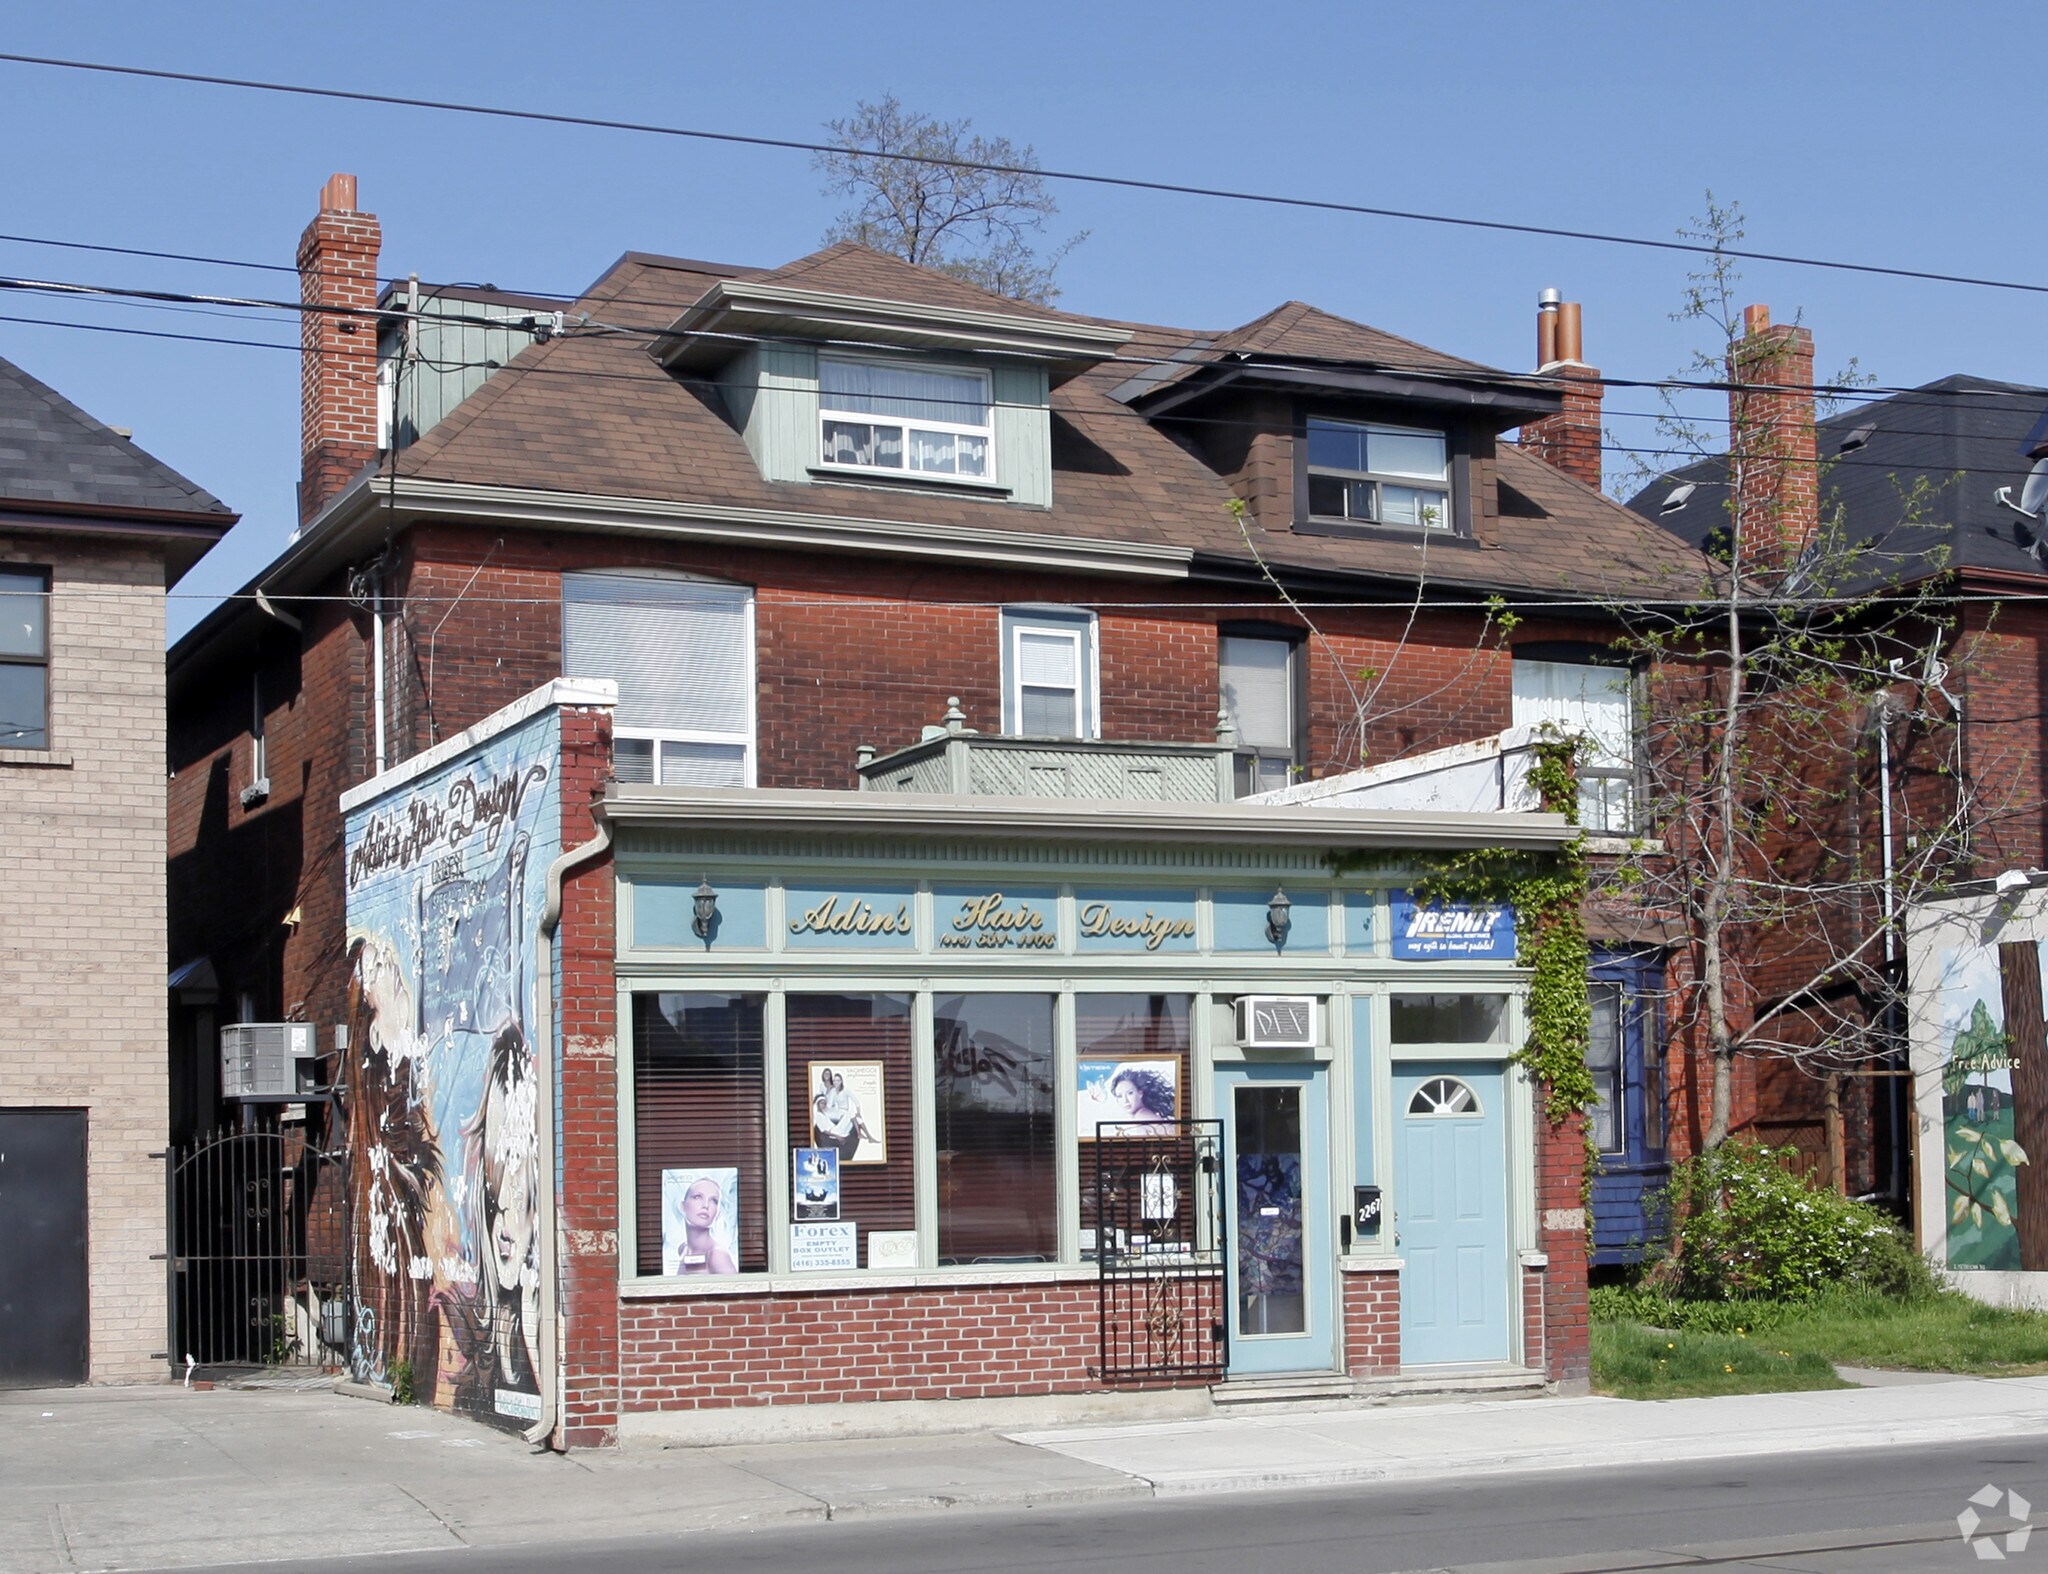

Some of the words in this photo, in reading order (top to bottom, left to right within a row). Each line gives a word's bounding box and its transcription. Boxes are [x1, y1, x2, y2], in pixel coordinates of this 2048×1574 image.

[401, 798, 447, 870] Hair
[449, 765, 548, 852] Design
[790, 894, 912, 934] Adin's
[953, 893, 1043, 931] Hair
[1081, 903, 1196, 949] Design
[1952, 1055, 1977, 1071] Free
[1981, 1053, 2020, 1070] Advice
[1359, 1198, 1380, 1221] 2267
[794, 1225, 849, 1237] Forex
[793, 1260, 813, 1268] (416)
